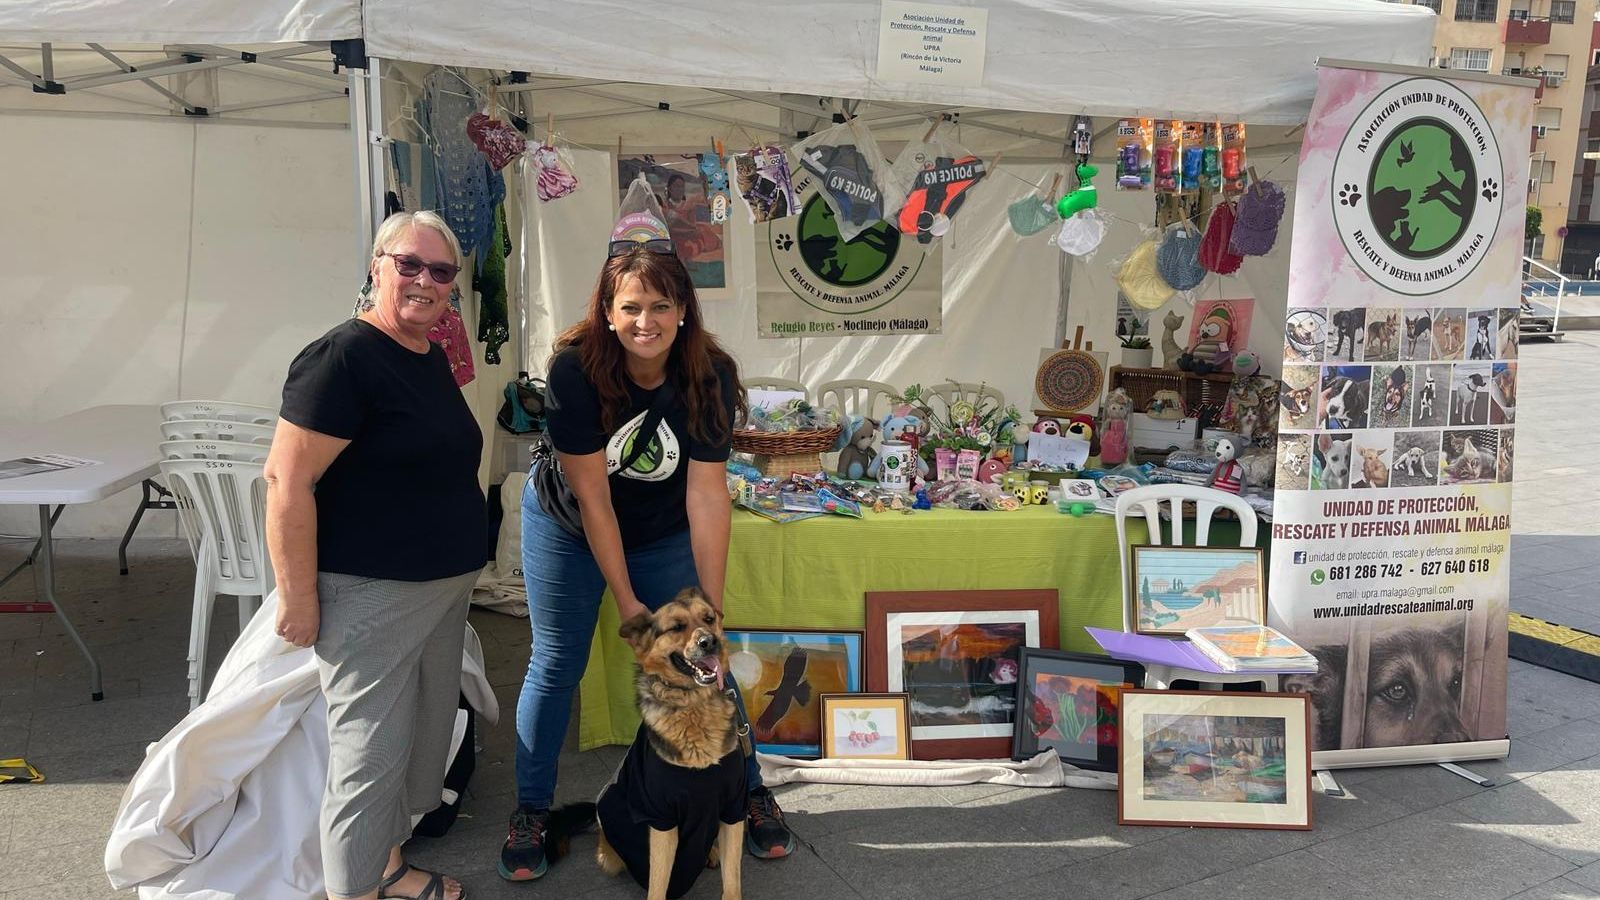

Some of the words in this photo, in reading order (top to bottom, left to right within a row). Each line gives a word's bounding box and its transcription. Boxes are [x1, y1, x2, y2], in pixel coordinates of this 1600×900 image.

[903, 13, 934, 22] Asociación
[935, 16, 956, 24] Unidad
[890, 21, 923, 31] Protección,
[924, 25, 947, 33] Rescate
[952, 27, 976, 35] Defensa
[900, 52, 923, 61] (Rincón
[939, 56, 962, 64] Victoria
[919, 64, 943, 73] Málaga)
[1357, 99, 1401, 153] ASOCIACIÓN
[1401, 92, 1433, 107] UNIDAD
[1435, 94, 1447, 106] DE
[830, 175, 845, 192] K9
[924, 170, 938, 186] K9
[939, 166, 973, 183] POLICE
[842, 181, 878, 203] POLICE
[1352, 229, 1382, 267] RESCATE
[1382, 262, 1390, 271] Y
[1389, 265, 1422, 283] DEFENSA
[789, 267, 815, 294] RESCATE
[815, 290, 822, 298] Y
[822, 294, 853, 304] DEFENSA
[771, 321, 807, 334] Refugio
[809, 320, 835, 333] Reyes
[843, 319, 887, 331] Moclinejo
[889, 318, 929, 331] (Málaga)
[1323, 500, 1373, 518] UNIDAD
[1377, 499, 1394, 515] DE
[1399, 493, 1479, 515] PROTECCIÓN,
[1273, 523, 1336, 540] RESCATE
[1340, 523, 1348, 538] Y
[1351, 520, 1410, 538] DEFENSA
[1413, 517, 1461, 536] ANIMAL
[1465, 513, 1510, 532] MÁLAGA
[1308, 551, 1335, 562] unidad
[1336, 551, 1346, 561] de
[1347, 549, 1390, 562] protección,
[1392, 548, 1419, 559] rescate
[1420, 549, 1425, 559] y
[1426, 547, 1454, 557] defensa
[1454, 544, 1479, 555] animal
[1480, 543, 1505, 555] málaga
[1329, 566, 1351, 581] 681
[1354, 564, 1377, 579] 286
[1380, 563, 1403, 578] 742
[1421, 561, 1442, 576] 627
[1444, 560, 1466, 574] 640
[1469, 558, 1490, 573] 618
[1336, 589, 1359, 600] email:
[1361, 585, 1455, 600] upra.malaga@gmail.com
[1313, 598, 1474, 619] www.unidadrescateanimal.org
